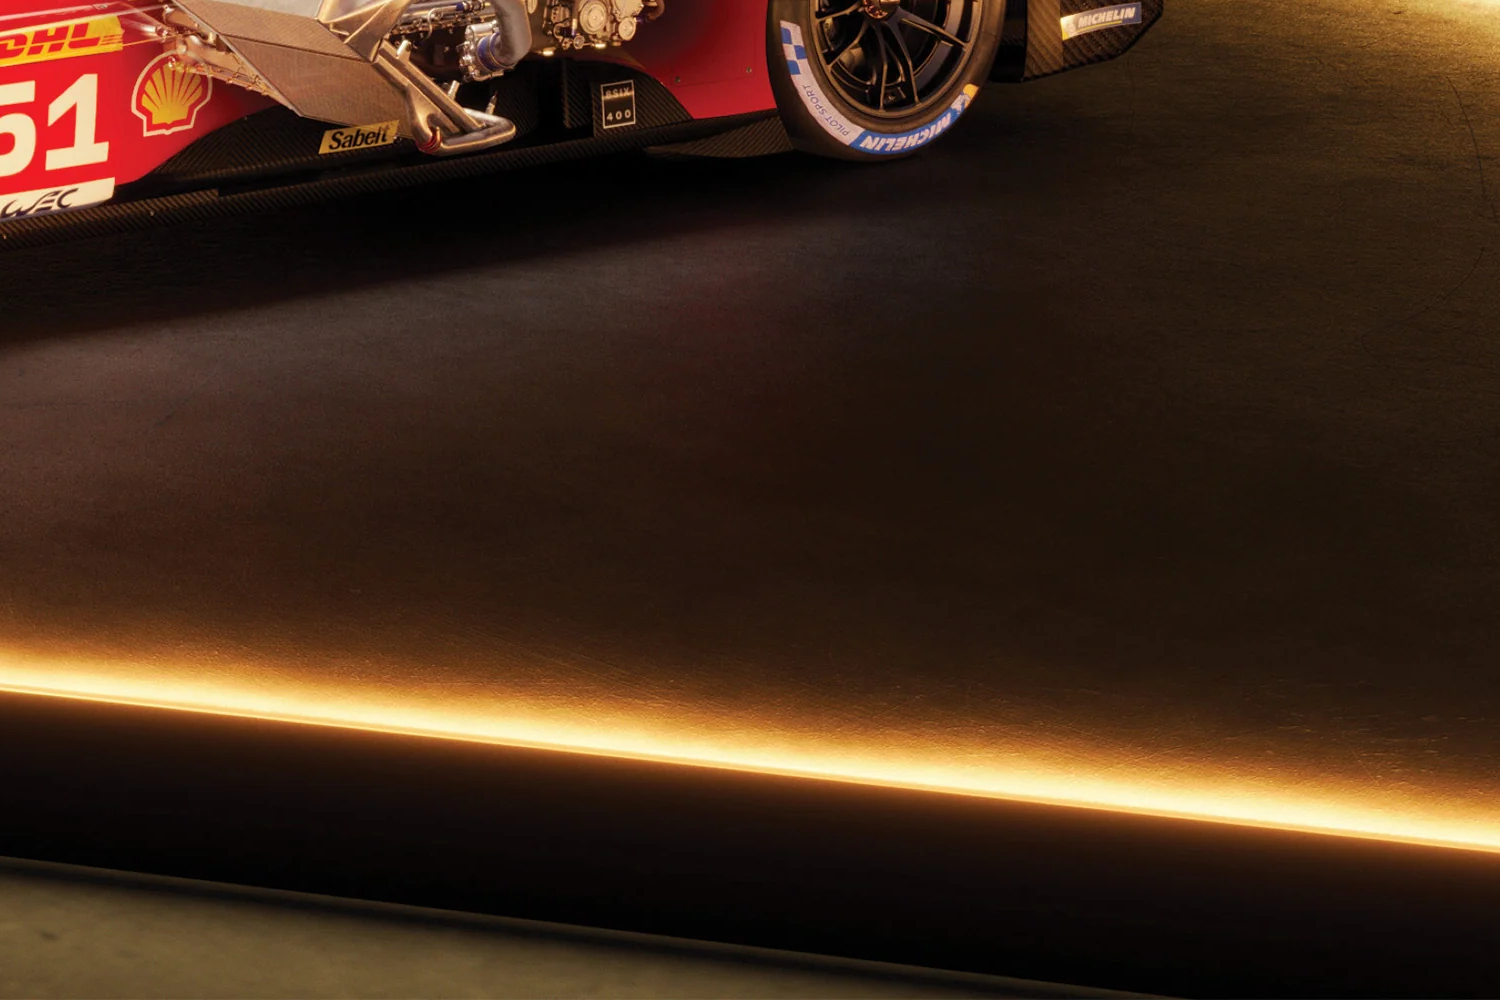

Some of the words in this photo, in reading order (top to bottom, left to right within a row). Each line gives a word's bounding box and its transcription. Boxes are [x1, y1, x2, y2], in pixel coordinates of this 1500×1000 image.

[1077, 7, 1137, 29] MICHELIN
[802, 84, 828, 115] SPORT
[606, 109, 631, 121] 400
[824, 114, 850, 137] PILOT
[328, 124, 390, 150] Sabelt
[859, 112, 952, 152] MICHELIN
[0, 187, 79, 219] WEC
